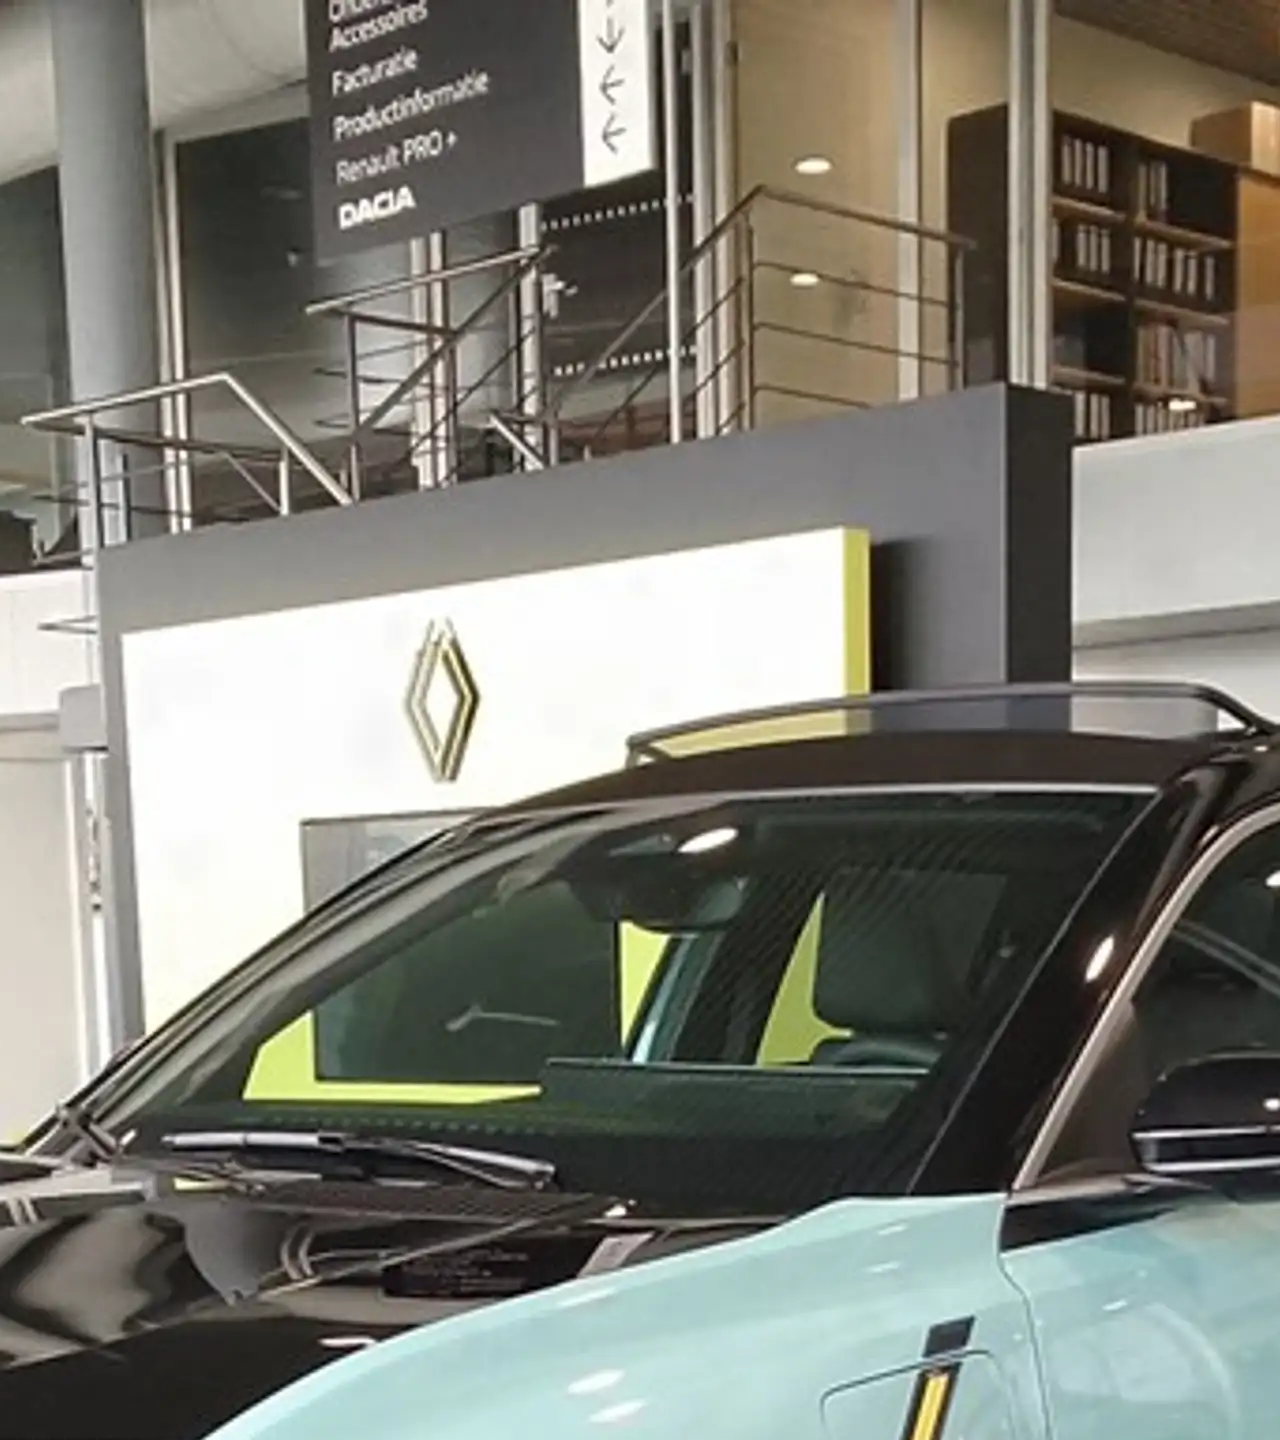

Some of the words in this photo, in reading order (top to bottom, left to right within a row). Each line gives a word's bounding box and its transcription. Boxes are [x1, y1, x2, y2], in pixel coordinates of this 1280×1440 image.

[329, 5, 428, 53] Accessoires
[332, 45, 418, 96] Facturatie
[333, 68, 489, 142] Productinformatie
[336, 144, 401, 187] Renault
[403, 128, 443, 165] PRO
[339, 184, 417, 230] DACIA
